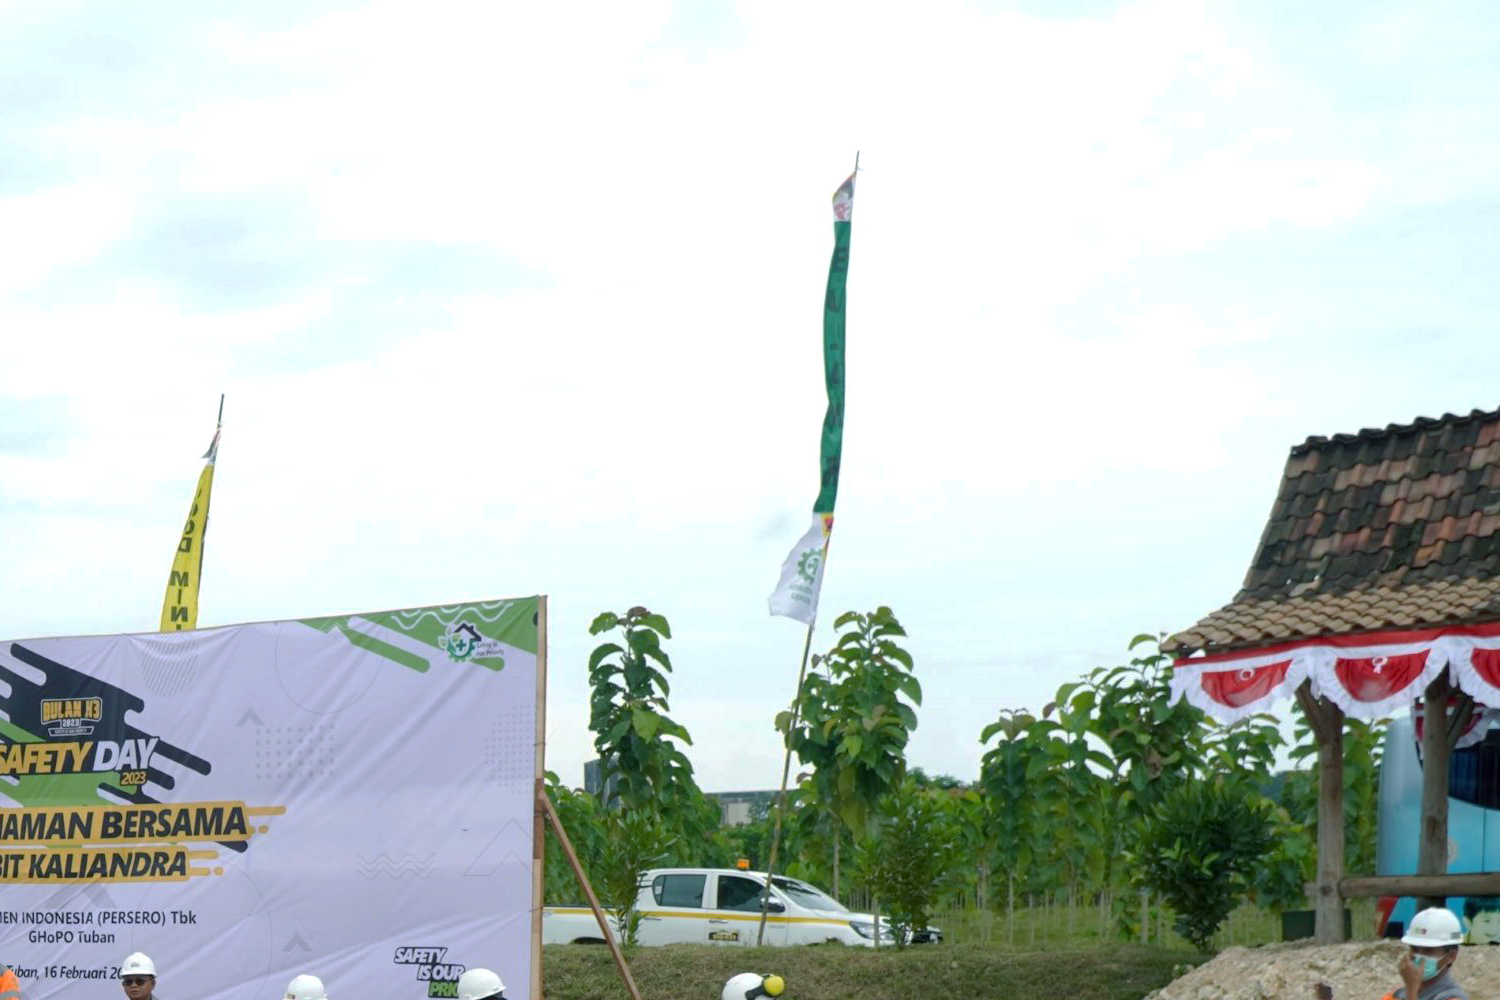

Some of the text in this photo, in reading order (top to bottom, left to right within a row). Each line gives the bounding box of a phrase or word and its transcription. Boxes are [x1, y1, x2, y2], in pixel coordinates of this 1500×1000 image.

[42, 699, 100, 721] BULAN K3
[93, 737, 160, 771] DAY
[120, 771, 148, 786] 2023
[100, 806, 248, 839] BERSAMA
[28, 851, 187, 878] KALIANDRA
[22, 911, 94, 925] INDONESIA
[97, 909, 166, 927] (PERSERO)
[171, 909, 197, 924] Tbk
[28, 930, 116, 944] GHoPO Tuban
[394, 948, 447, 963] SAFETY
[44, 966, 58, 979] 16
[60, 965, 107, 980] Februari
[109, 966, 123, 980] 20
[418, 965, 464, 980] IS OUR
